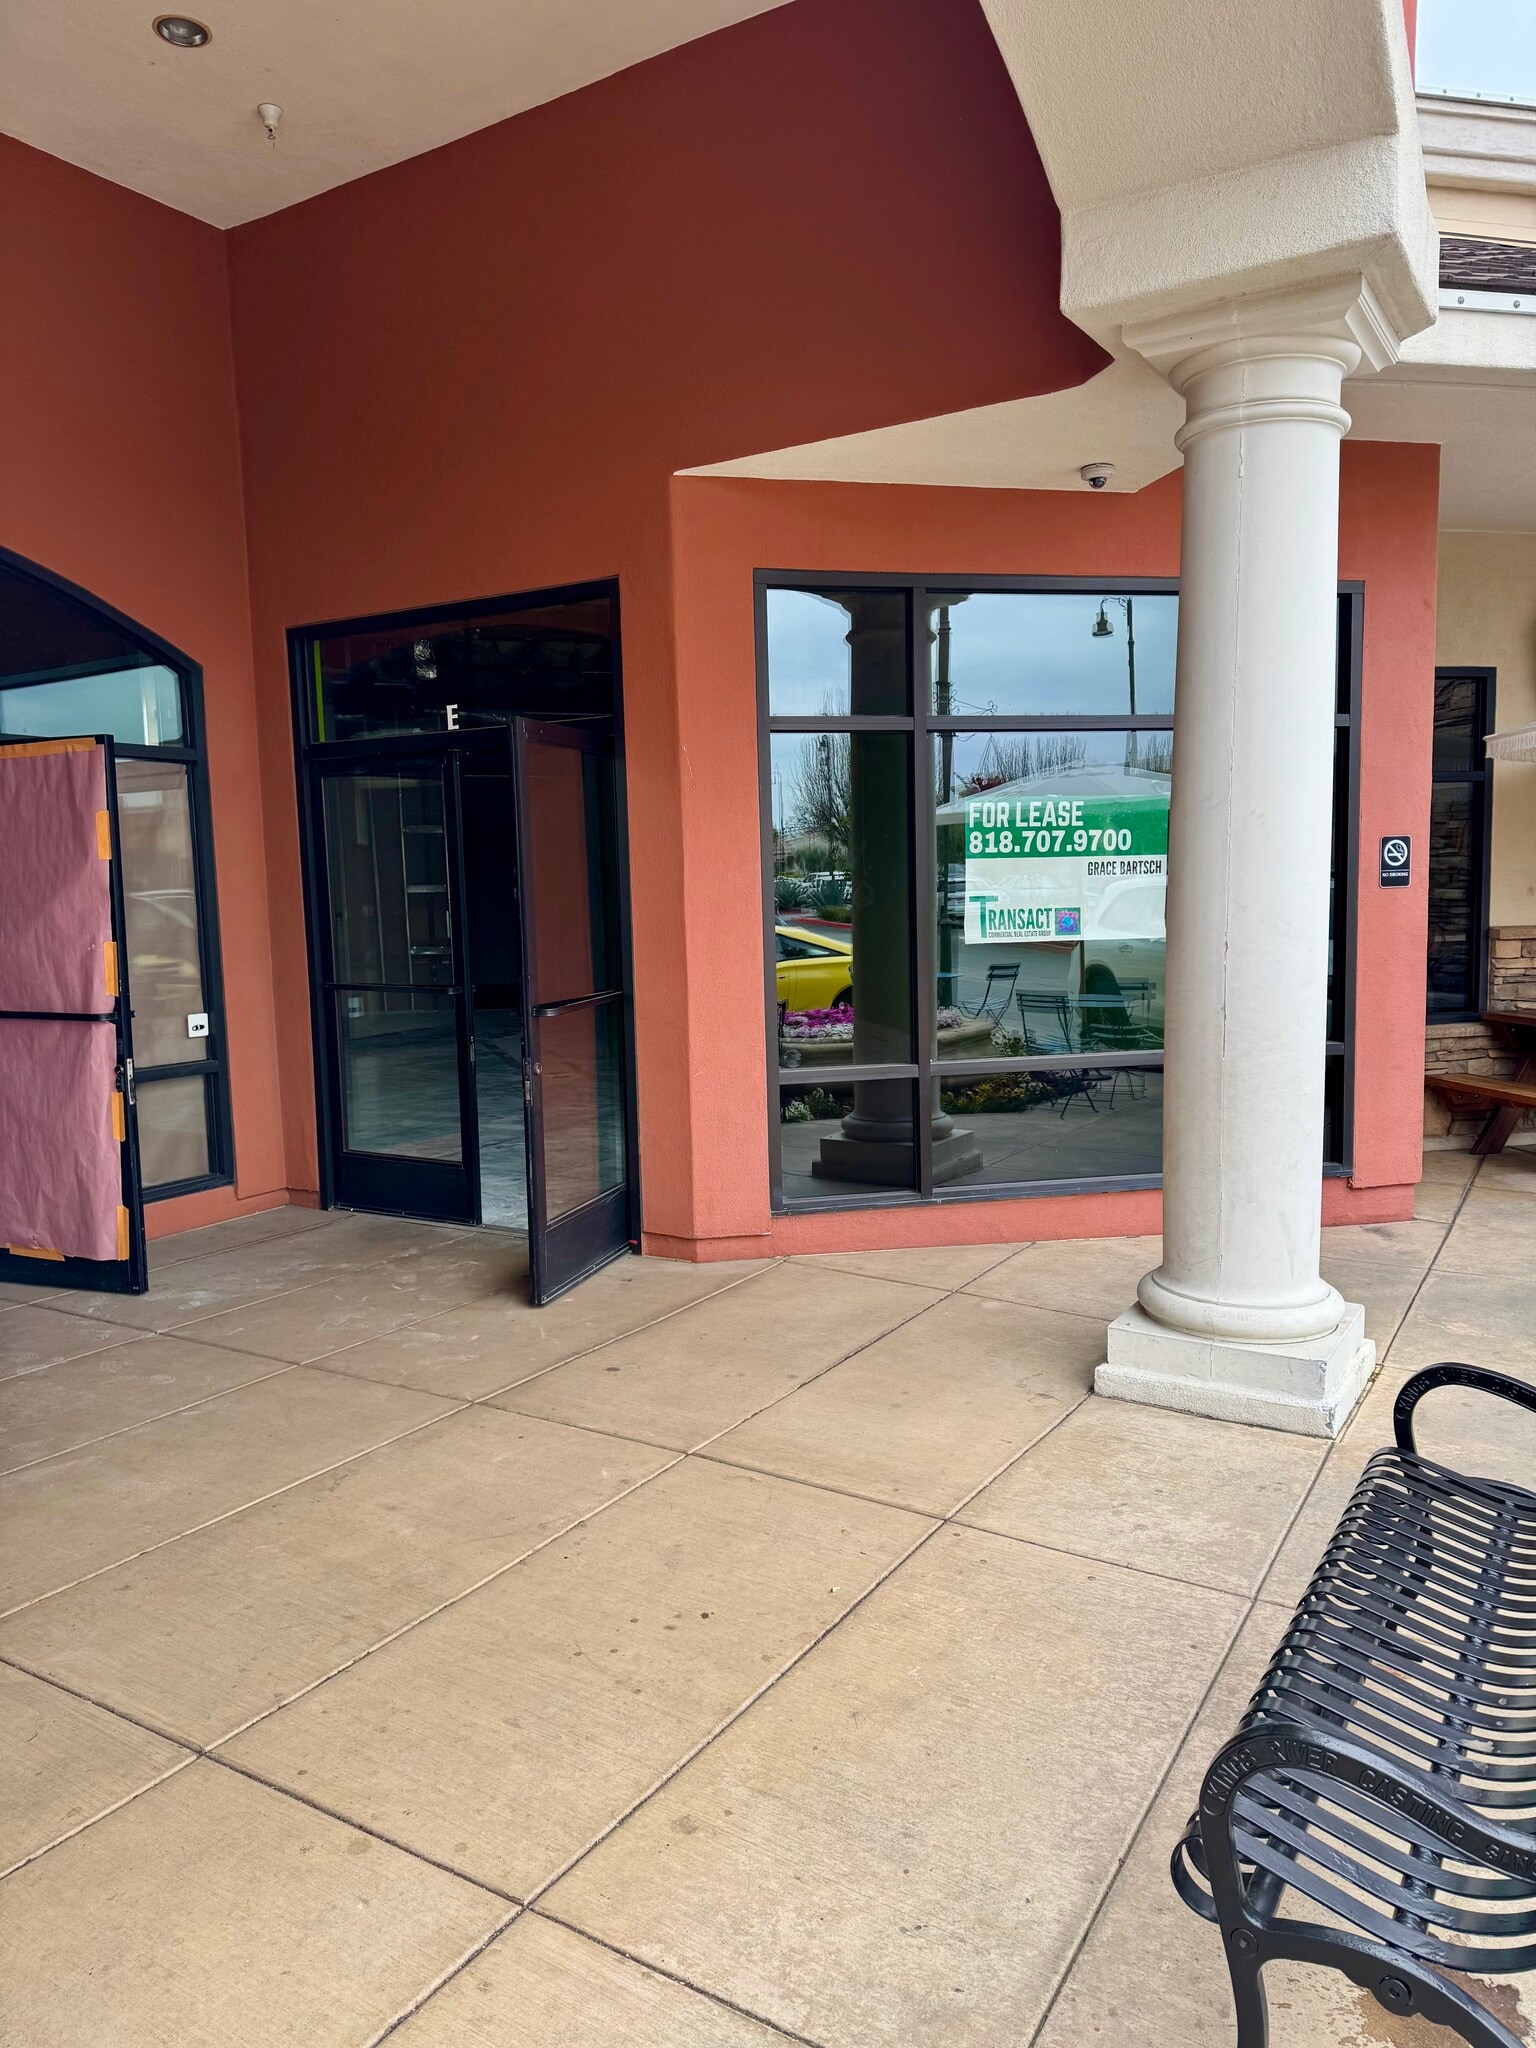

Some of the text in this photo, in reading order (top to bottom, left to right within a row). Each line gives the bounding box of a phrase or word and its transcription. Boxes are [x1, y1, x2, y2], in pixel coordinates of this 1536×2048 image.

[446, 704, 460, 730] E
[969, 800, 1085, 828] FOR LEASE
[969, 828, 1132, 854] 818.707.9700
[1087, 860, 1162, 876] GRACE BARTSCH
[969, 896, 1053, 938] TRANSACT
[1267, 1740, 1339, 1774] RIVER
[1358, 1768, 1466, 1845] CASTING
